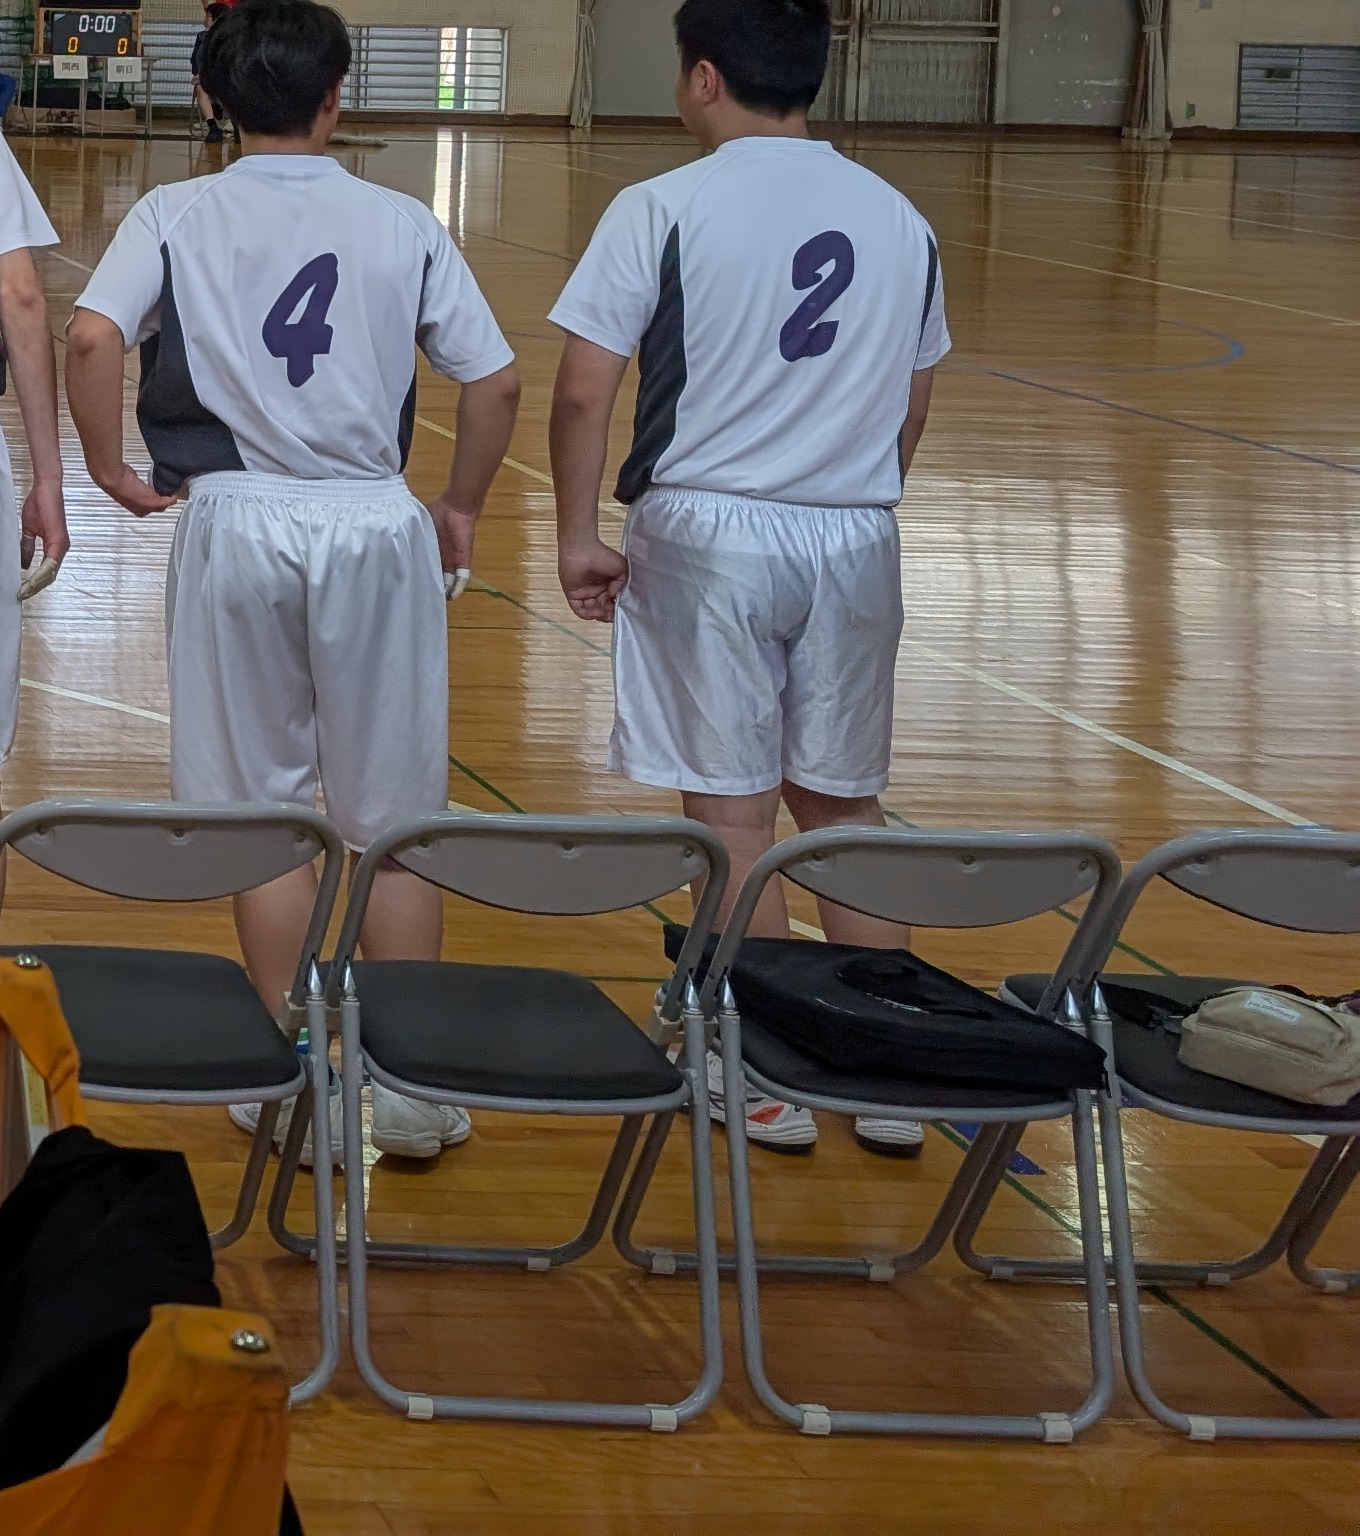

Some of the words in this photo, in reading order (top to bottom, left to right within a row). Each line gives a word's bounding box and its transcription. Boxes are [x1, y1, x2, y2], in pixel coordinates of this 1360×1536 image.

[79, 15, 116, 33] 0:00
[68, 37, 79, 53] 0
[118, 38, 128, 54] 0
[778, 230, 856, 363] 2
[261, 251, 340, 390] 4
